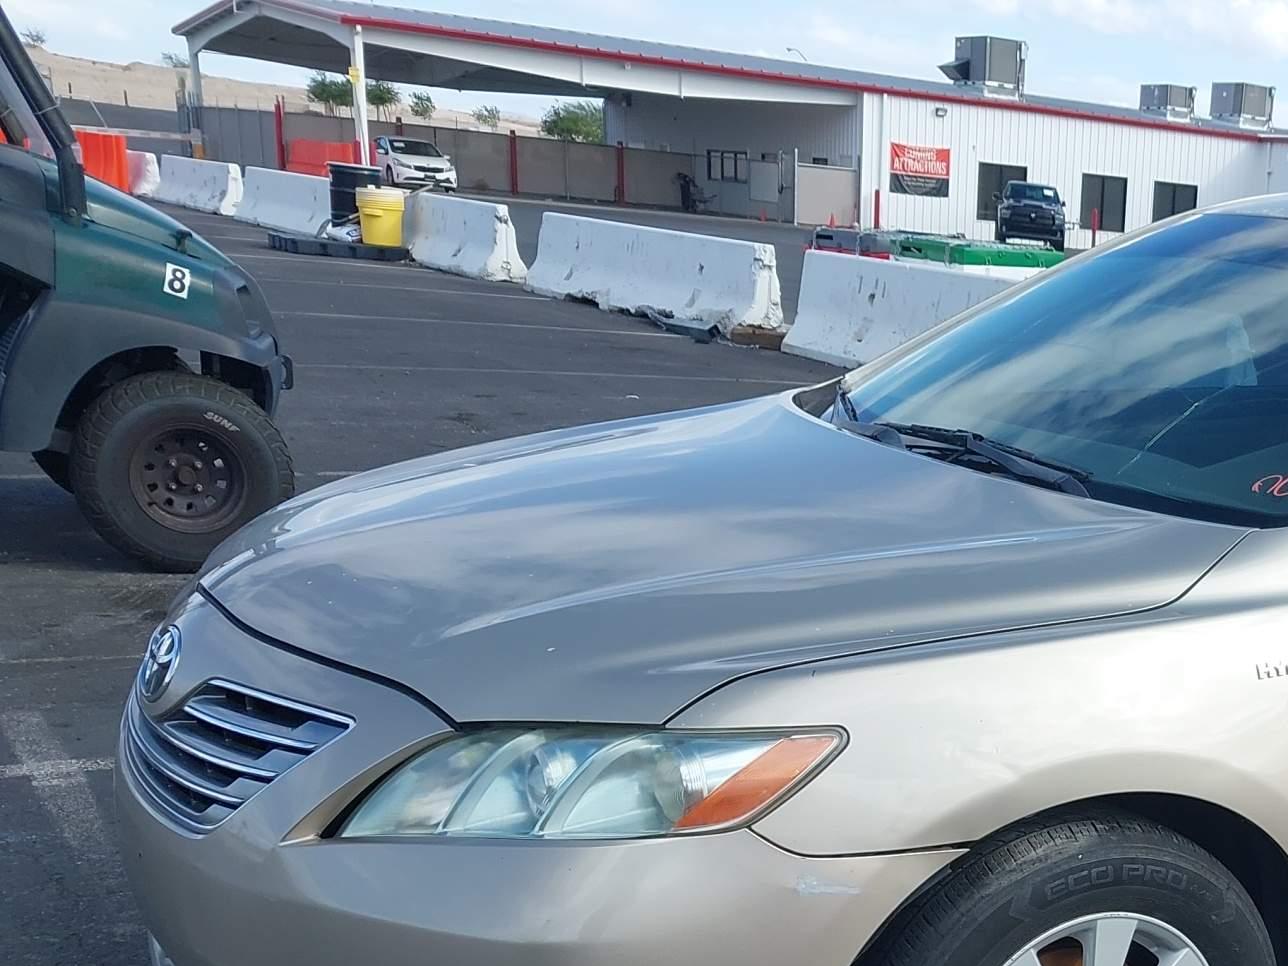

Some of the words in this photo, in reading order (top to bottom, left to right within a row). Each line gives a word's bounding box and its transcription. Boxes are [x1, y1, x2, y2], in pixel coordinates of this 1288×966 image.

[893, 157, 947, 175] ATTRACTIONS
[168, 268, 186, 293] 8
[1045, 865, 1114, 901] ECO
[1122, 864, 1188, 891] PRO
